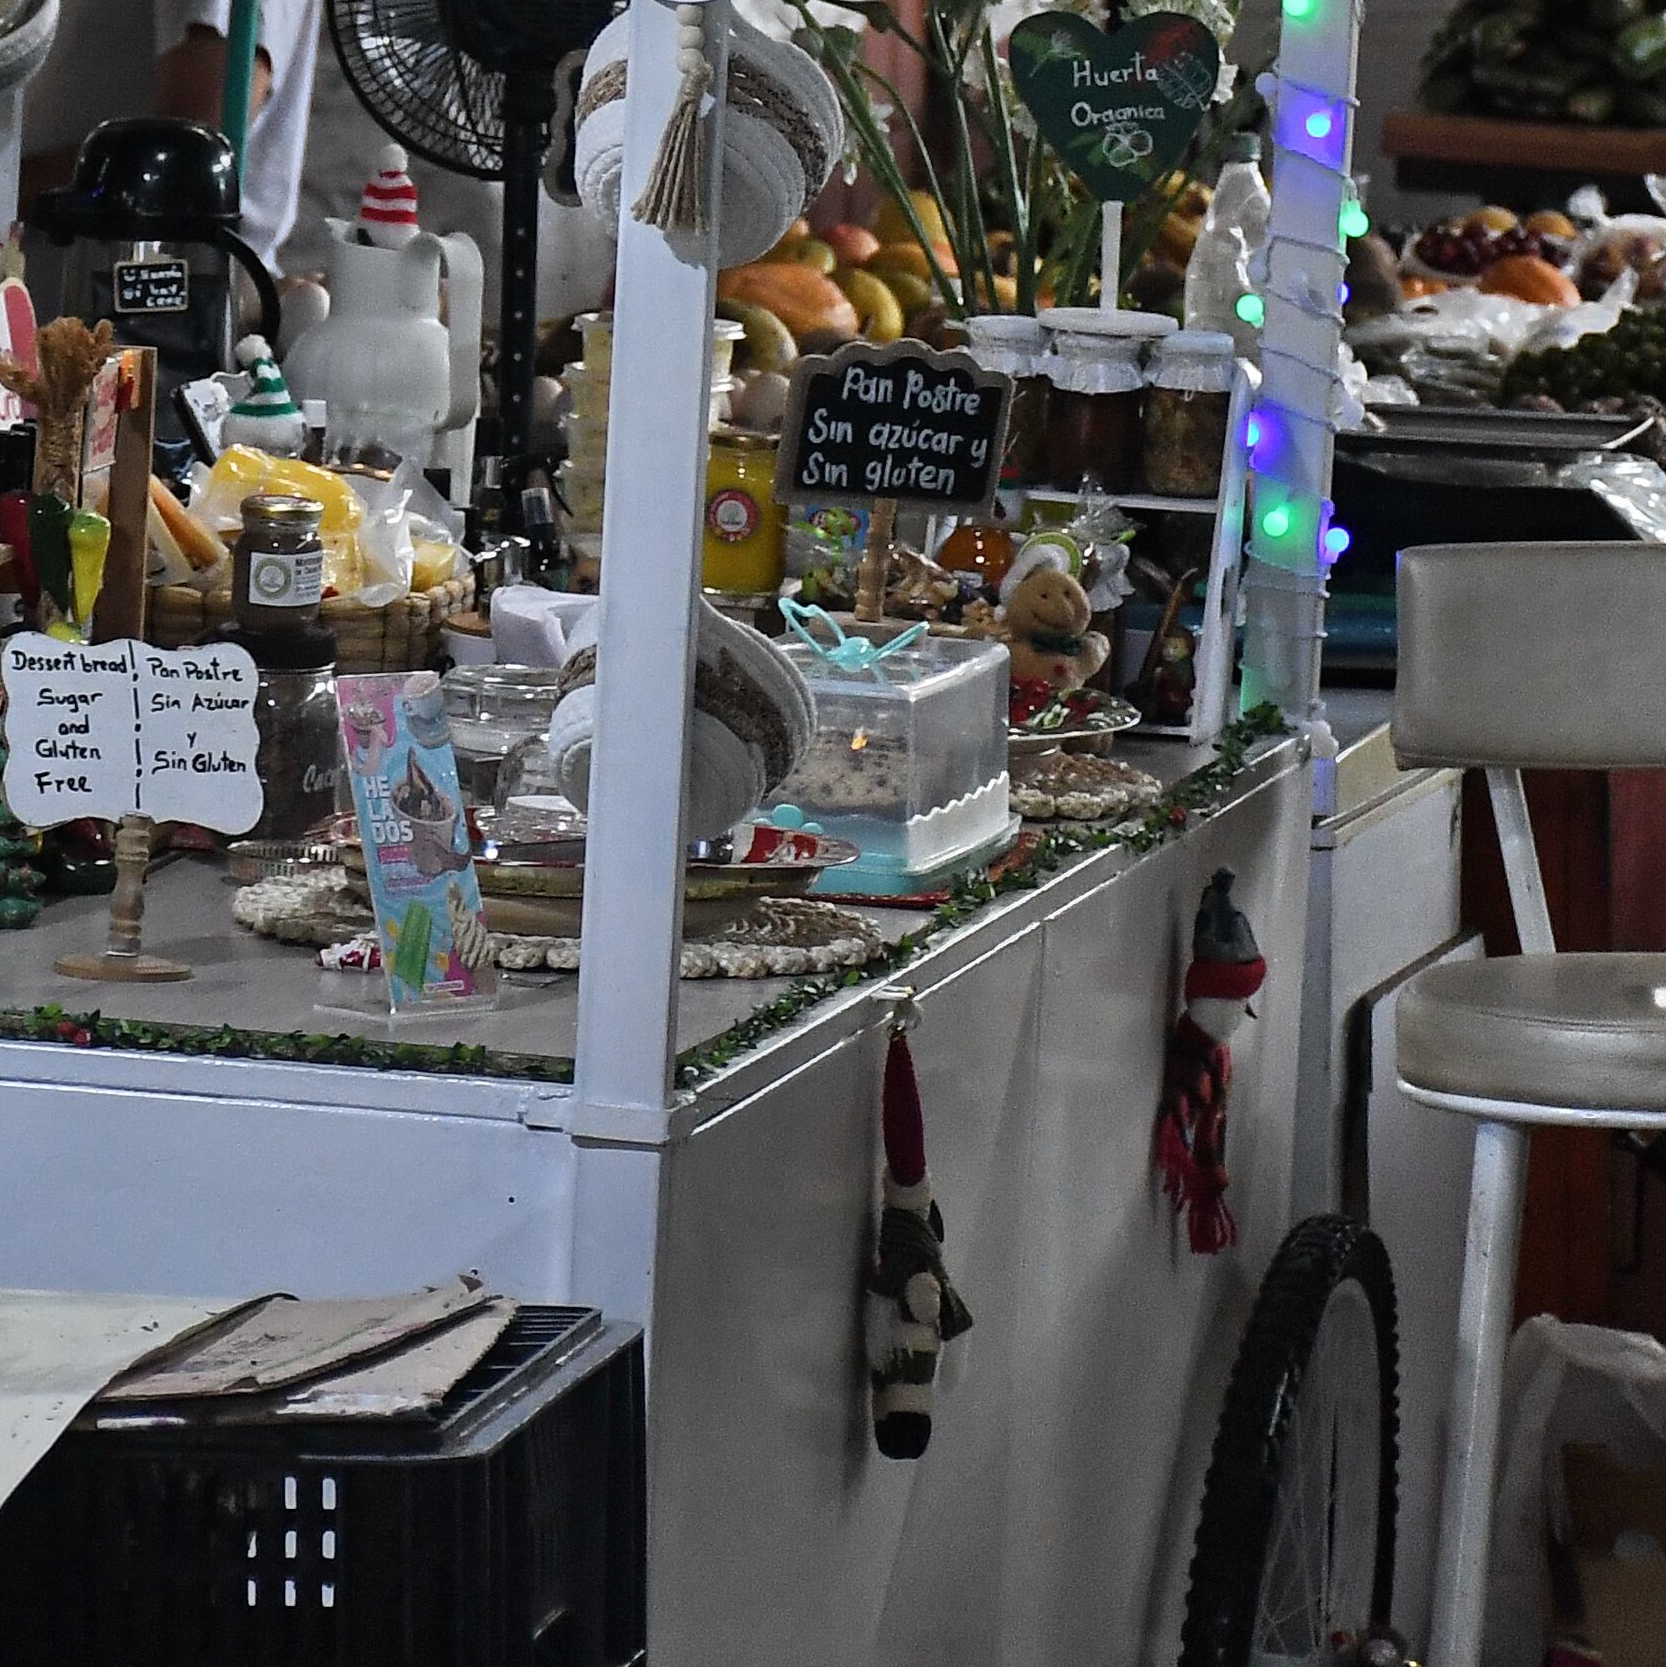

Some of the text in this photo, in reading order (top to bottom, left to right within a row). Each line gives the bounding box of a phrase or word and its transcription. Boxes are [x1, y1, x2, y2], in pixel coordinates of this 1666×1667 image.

[1072, 52, 1159, 87] Huerta
[841, 365, 981, 416] Pan Postre
[808, 407, 988, 468] Sin azúcar y
[801, 451, 955, 495] Sin gluten
[10, 650, 129, 675] Dessert bread
[146, 657, 244, 682] Pan Postre
[36, 688, 104, 713] Sugar
[150, 695, 181, 713] Sin
[58, 714, 90, 735] and
[35, 739, 102, 760] Gluten
[186, 731, 197, 749] y
[151, 750, 247, 775] Sin Gluten
[34, 772, 93, 795] Free
[372, 821, 414, 844] DOS
